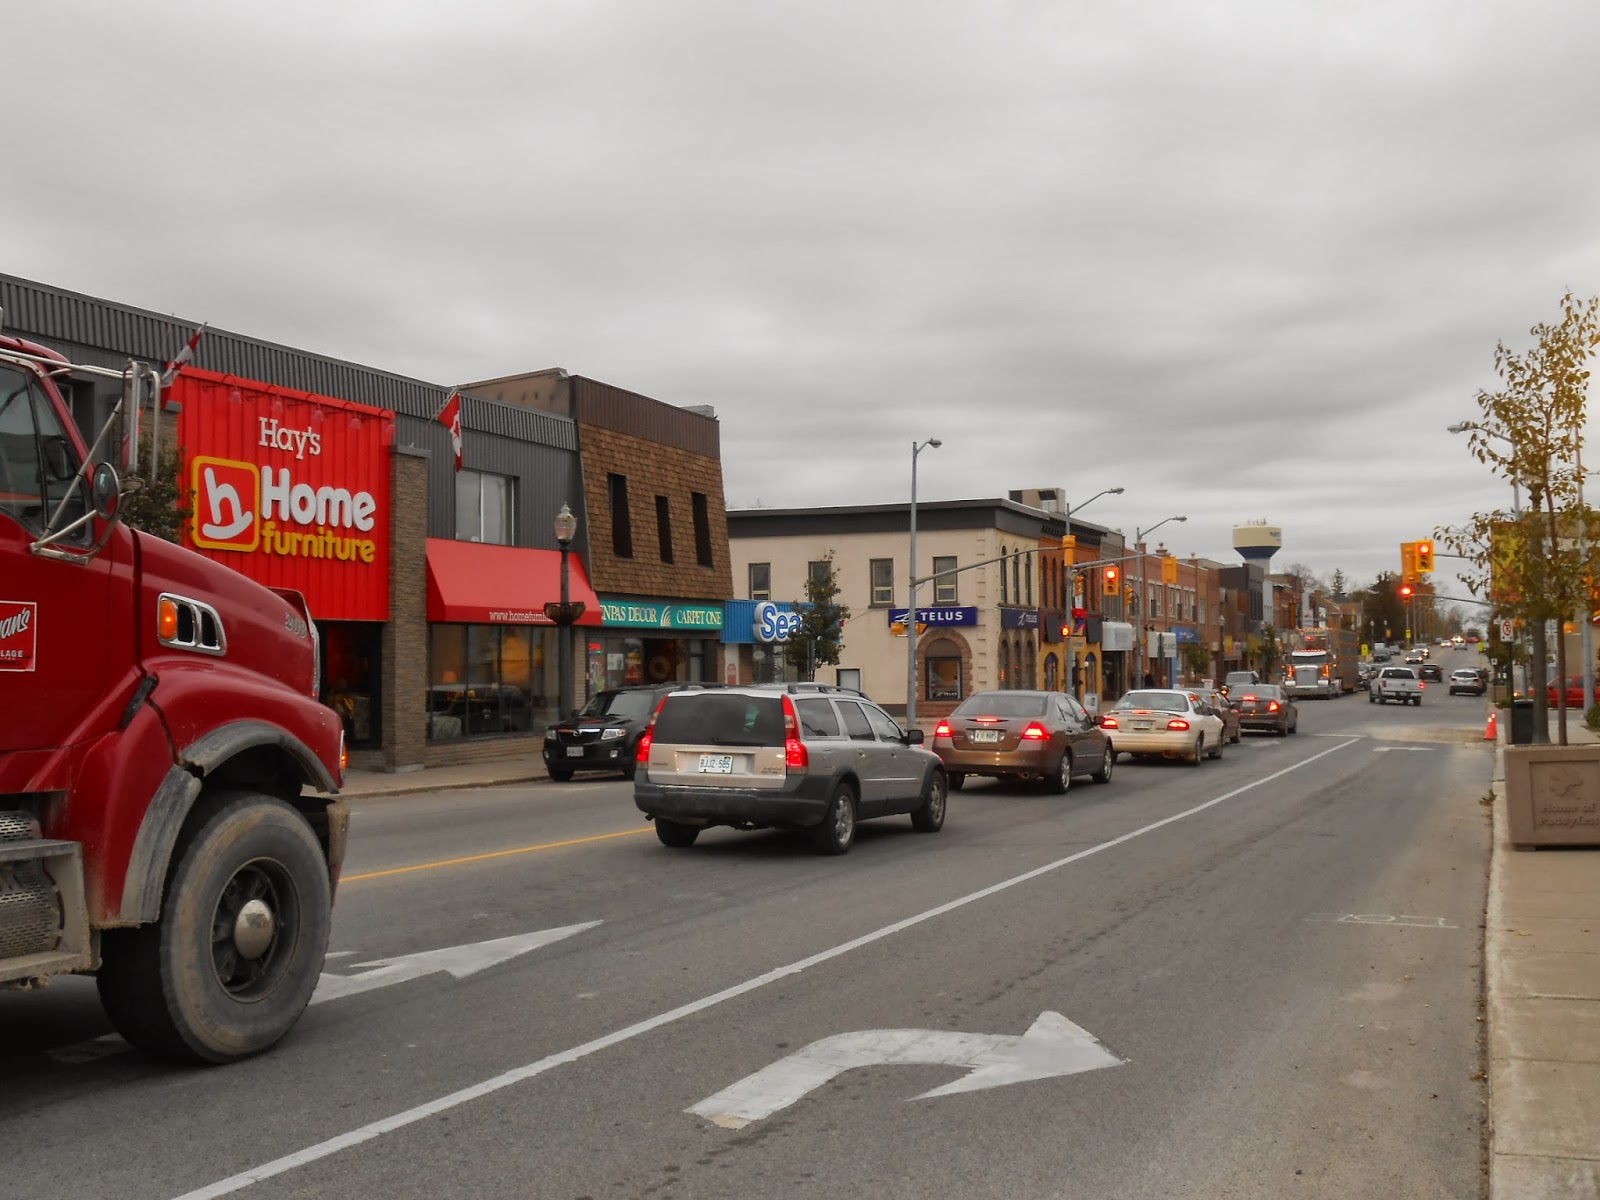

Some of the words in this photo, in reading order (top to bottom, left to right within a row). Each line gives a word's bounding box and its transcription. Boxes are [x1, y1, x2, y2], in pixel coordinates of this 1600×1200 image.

[258, 416, 321, 460] Hay's
[261, 465, 376, 532] Home
[261, 521, 376, 564] furniture
[628, 606, 657, 623] DECOR
[677, 609, 705, 625] CARPET
[706, 611, 722, 625] ONE
[757, 601, 804, 642] Sea
[920, 611, 963, 621] TELUS
[1025, 614, 1038, 624] TELUS
